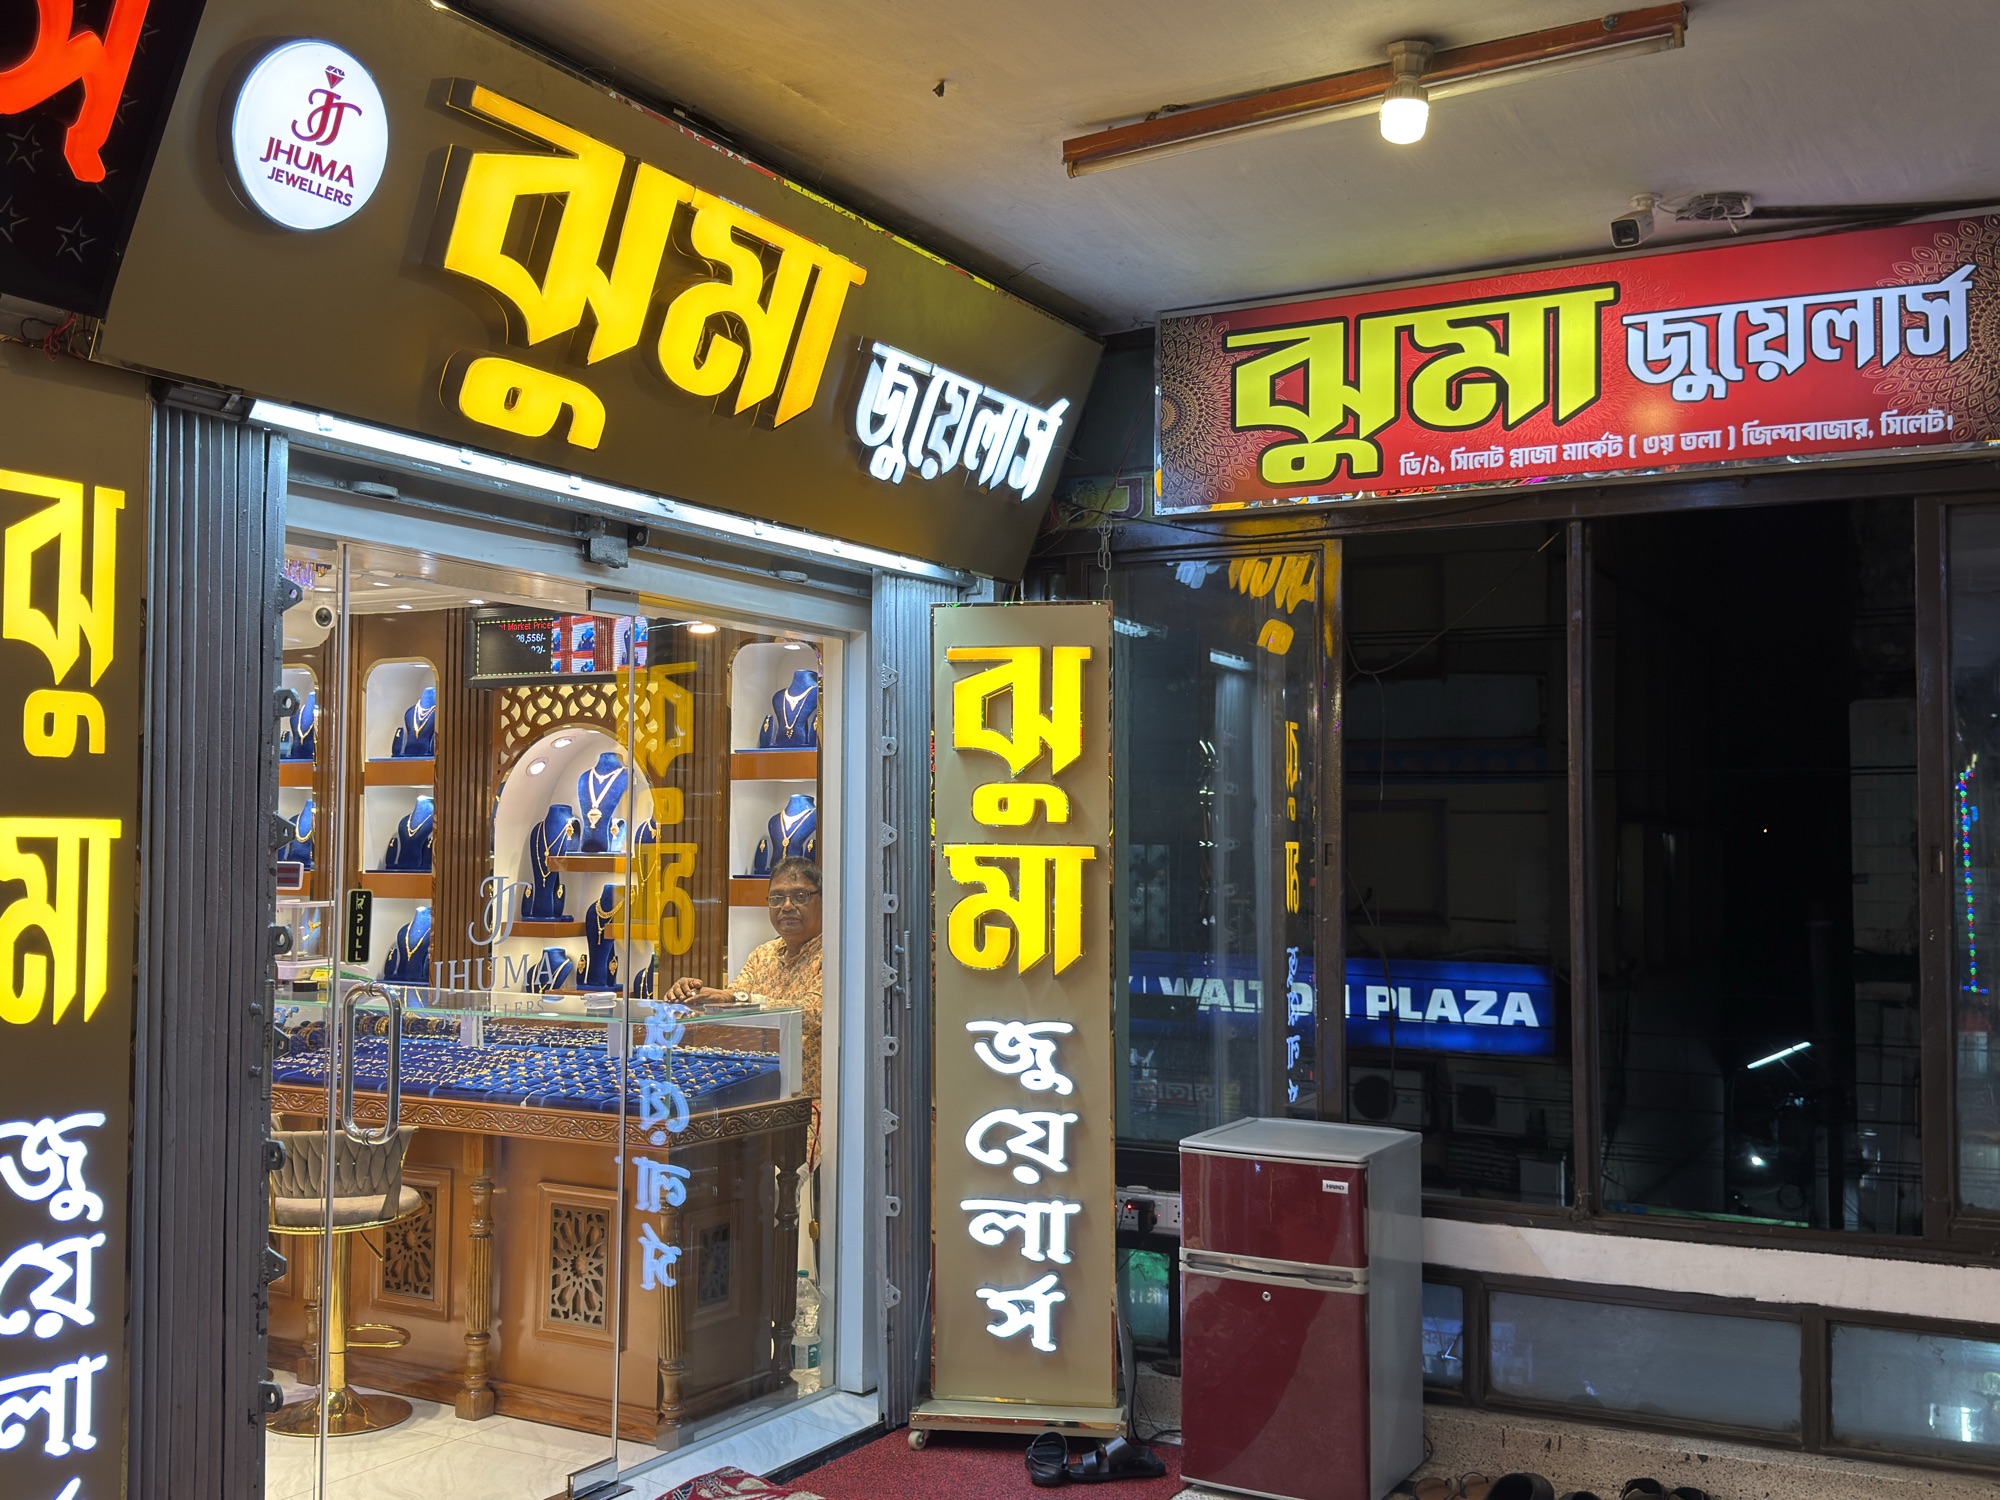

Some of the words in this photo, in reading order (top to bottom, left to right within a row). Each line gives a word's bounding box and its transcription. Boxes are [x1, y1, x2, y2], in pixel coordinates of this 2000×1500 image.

[259, 136, 355, 188] JHUMA
[267, 166, 353, 207] JEWELLERS
[445, 84, 868, 450] ঝুমা
[856, 339, 1070, 501] জুয়েলার্স
[1225, 282, 1619, 486] ঝুমা
[1622, 262, 1977, 402] জুয়েলার্স
[1399, 451, 1445, 476] ডি/১,
[1450, 445, 1504, 471] সিলেট
[1509, 444, 1557, 468] প্লাজা
[1562, 431, 1623, 461] মার্কেট
[1680, 430, 1721, 450] তলা
[1742, 418, 1874, 446] জিন্দাবাজার,
[508, 622, 532, 631] Market
[533, 621, 552, 630] Price
[945, 645, 1097, 978] ঝুমা
[354, 913, 364, 961] PULL
[432, 952, 554, 1005] JHUMA
[1365, 984, 1540, 1028] PLAZA
[960, 1019, 1082, 1353] জুয়েলার্স
